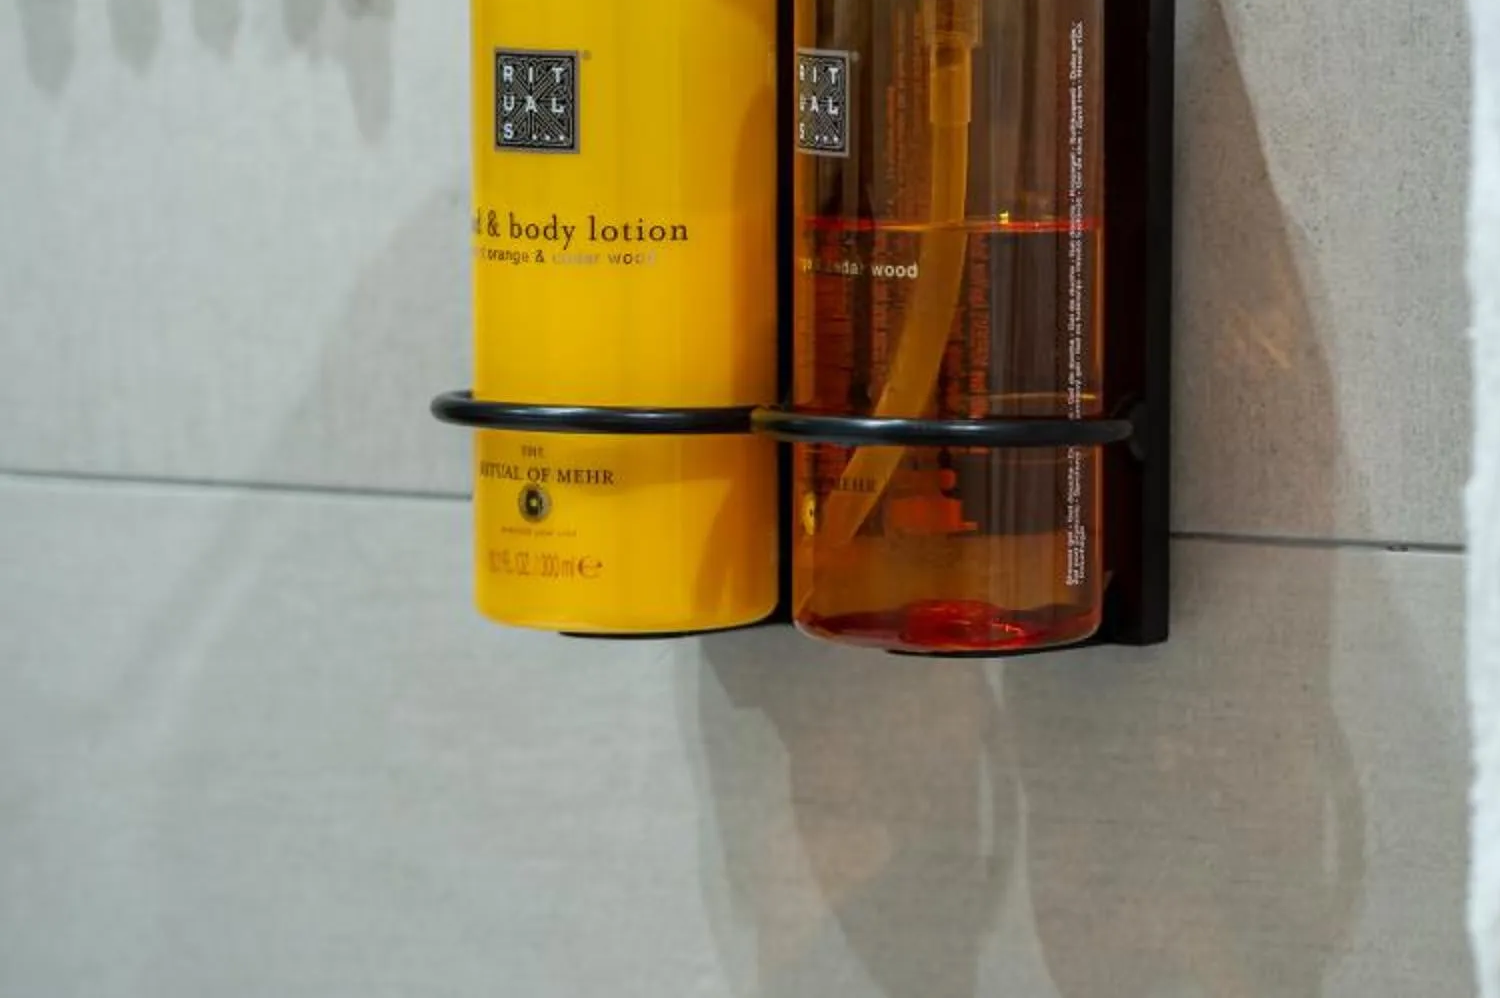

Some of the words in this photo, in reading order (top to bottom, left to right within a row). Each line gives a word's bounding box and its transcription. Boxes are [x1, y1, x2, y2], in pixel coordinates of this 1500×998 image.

[509, 211, 576, 250] body
[587, 215, 689, 241] lotion
[871, 262, 919, 280] wood
[528, 466, 551, 483] OF
[557, 468, 615, 486] MEHR
